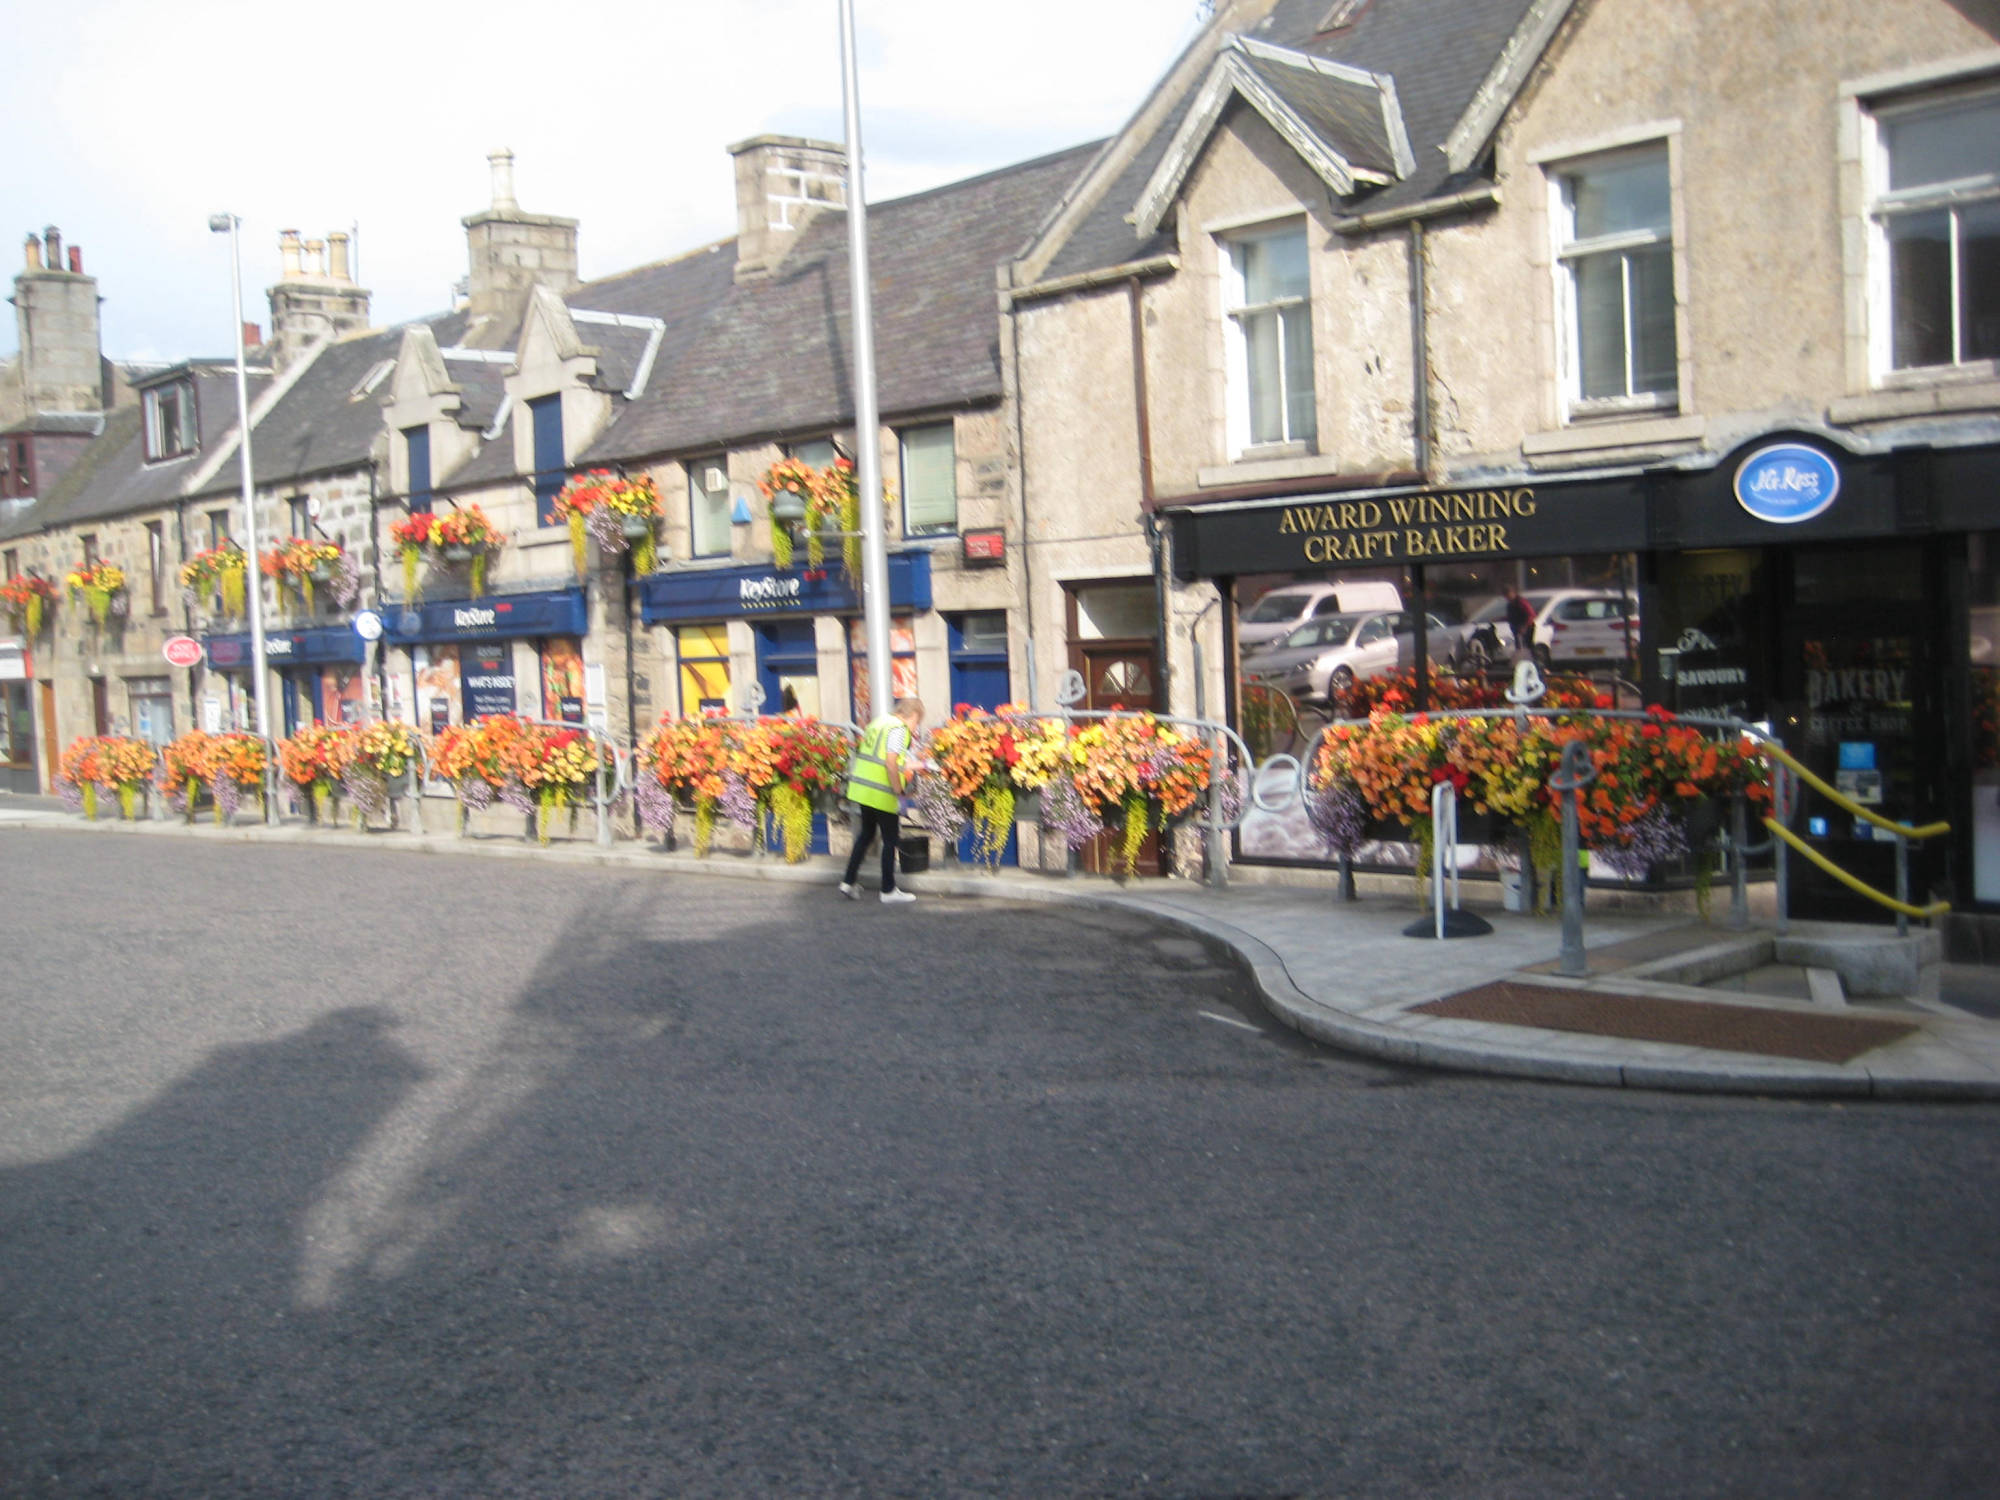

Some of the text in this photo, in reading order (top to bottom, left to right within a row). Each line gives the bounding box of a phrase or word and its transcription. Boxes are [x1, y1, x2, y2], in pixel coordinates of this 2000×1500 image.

[1279, 488, 1537, 534] AWARD WINNING
[1303, 523, 1510, 563] CRAFT BAKER
[740, 577, 800, 601] KeyStore
[1677, 668, 1746, 687] SAVOURY
[1808, 668, 1906, 707] BAKERY
